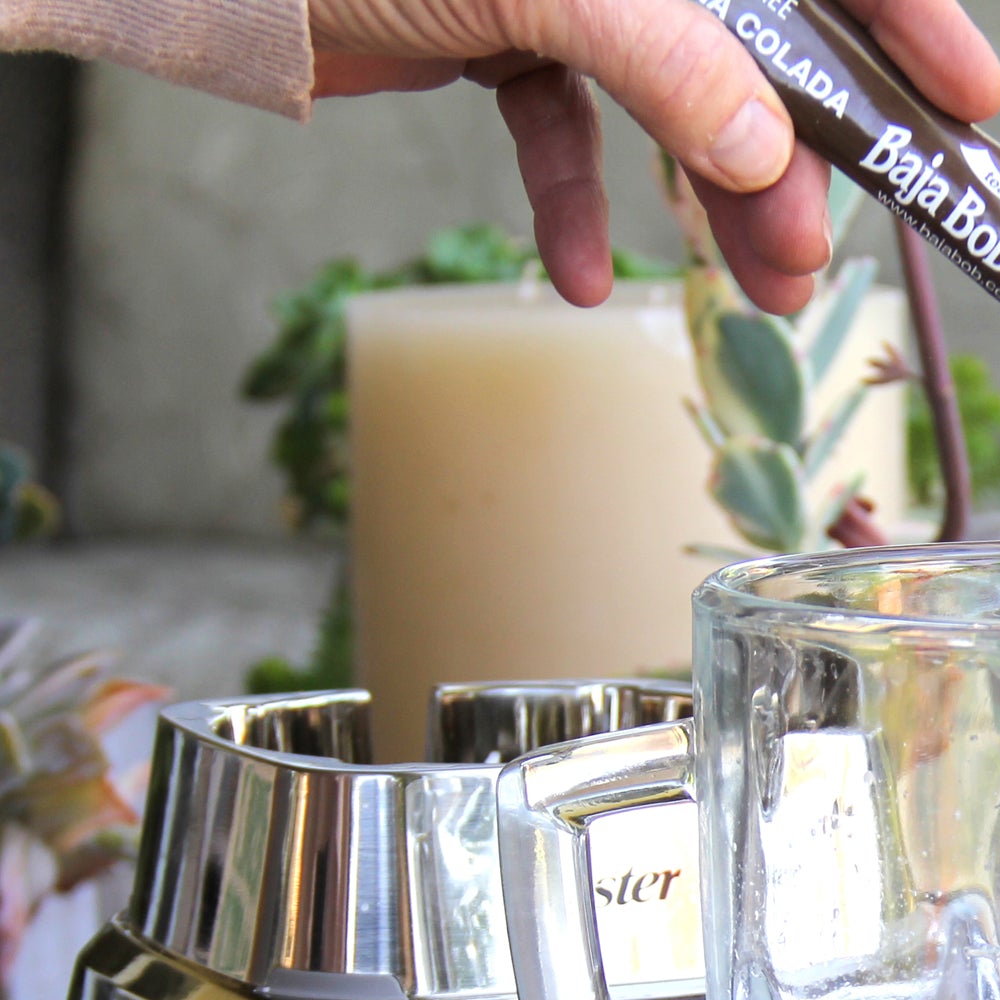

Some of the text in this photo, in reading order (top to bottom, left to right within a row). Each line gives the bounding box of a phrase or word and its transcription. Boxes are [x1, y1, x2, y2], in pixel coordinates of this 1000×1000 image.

[736, 12, 850, 120] COLADA
[859, 124, 950, 219] Baja
[595, 867, 682, 907] ster
